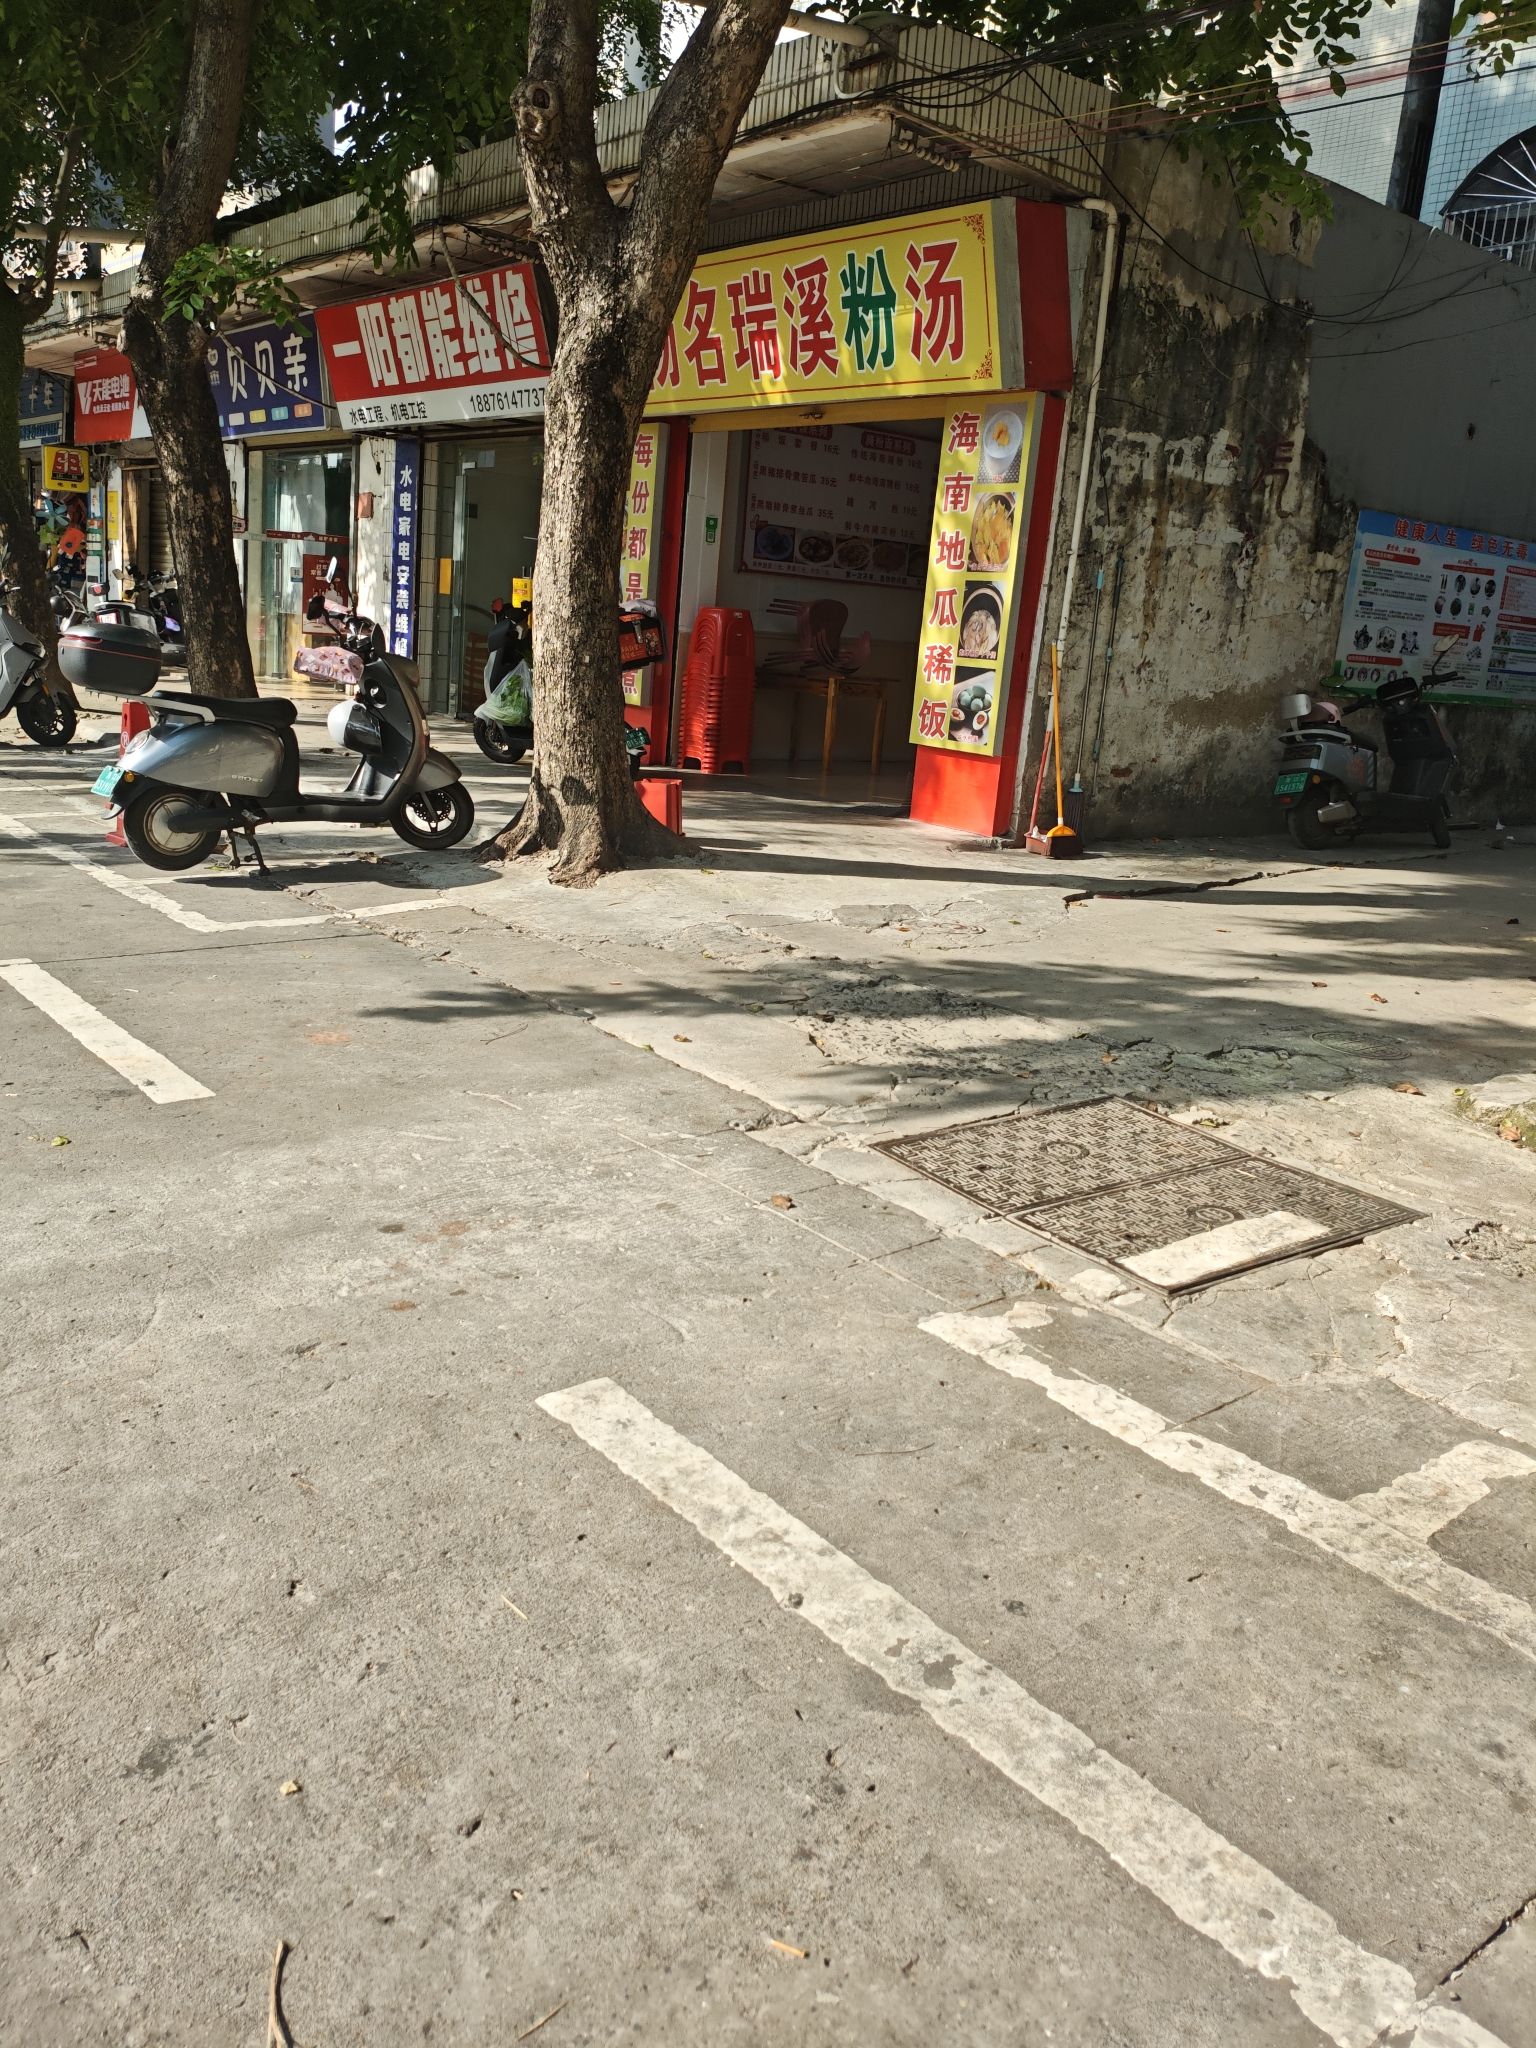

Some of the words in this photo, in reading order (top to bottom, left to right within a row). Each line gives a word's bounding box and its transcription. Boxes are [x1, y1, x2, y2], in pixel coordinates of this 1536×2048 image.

[332, 270, 540, 388] 一阳都能维修
[650, 239, 965, 388] 名瑞溪粉汤
[92, 374, 130, 402] 天能电池
[227, 333, 308, 402] 贝贝亲
[470, 387, 546, 413] 18876147737
[394, 465, 413, 656] 水电家电安装维修
[917, 410, 982, 740] 海南地瓜稀饭
[1394, 518, 1458, 547] 健康人生
[1471, 533, 1529, 561] 绿色无毒
